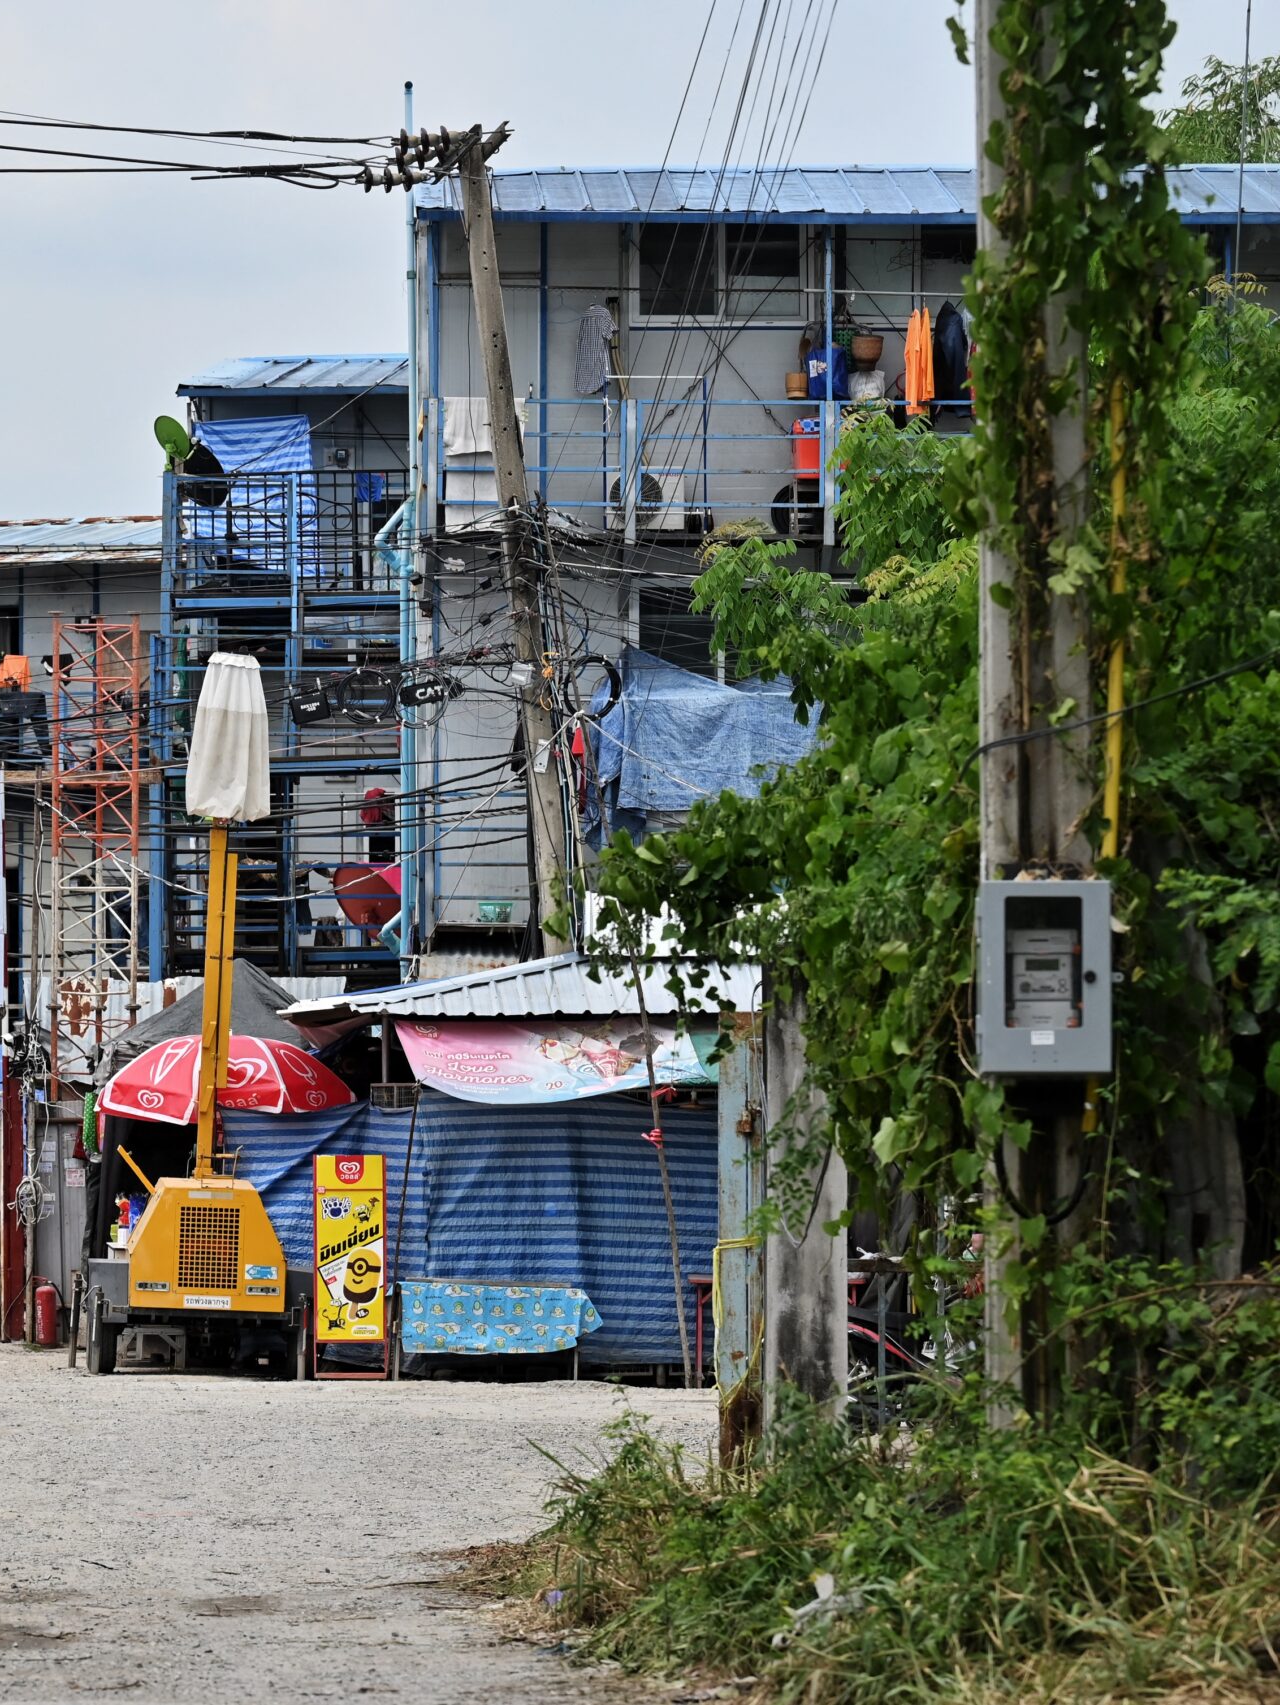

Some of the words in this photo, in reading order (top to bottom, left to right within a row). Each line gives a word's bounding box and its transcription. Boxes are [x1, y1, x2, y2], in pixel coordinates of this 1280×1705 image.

[415, 685, 443, 699] CAT
[423, 1064, 533, 1083] Hormones
[447, 1061, 497, 1074] Love
[320, 1224, 380, 1262] มินเนี่ยน
[185, 1296, 229, 1308] รถพ่วงลากจูง
